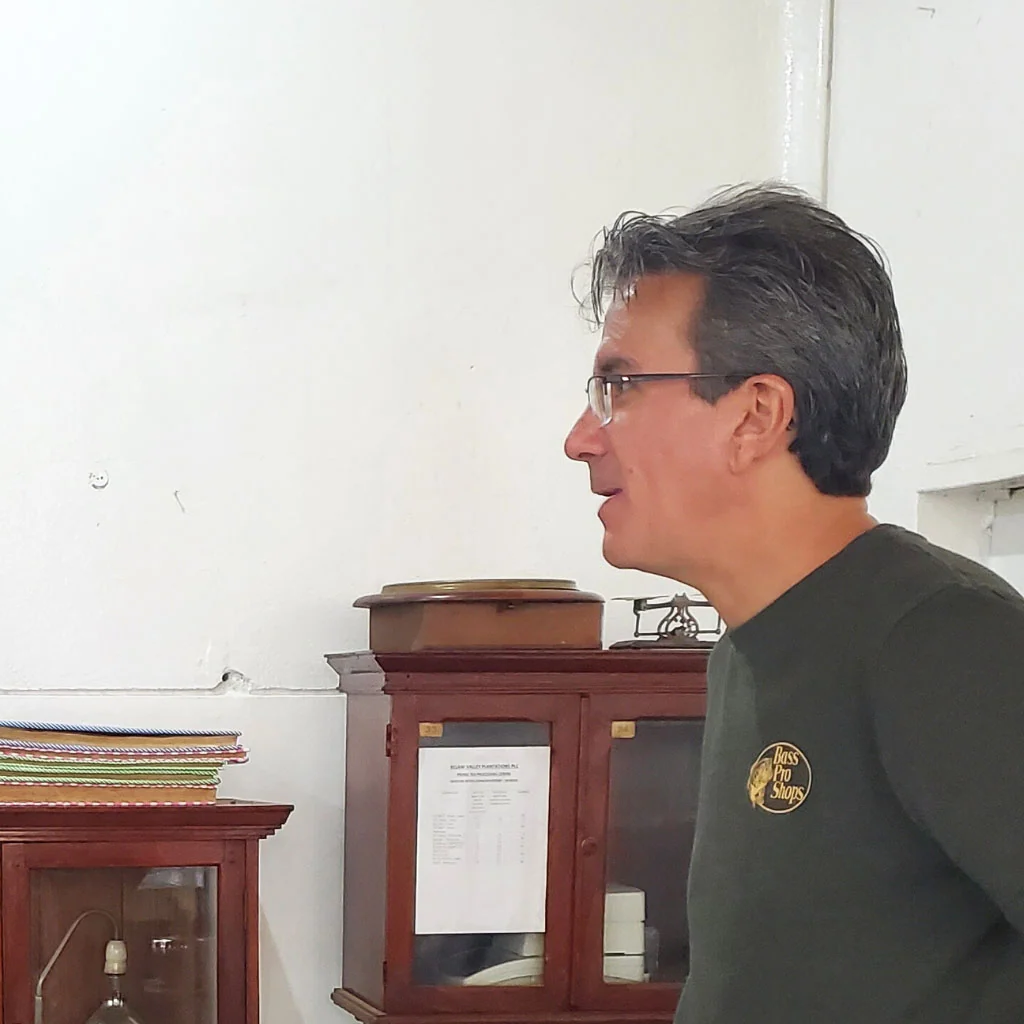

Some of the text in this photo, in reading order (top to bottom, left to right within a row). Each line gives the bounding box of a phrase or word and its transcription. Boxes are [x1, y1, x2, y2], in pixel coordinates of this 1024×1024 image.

[773, 745, 799, 766] Bass
[772, 764, 792, 783] Pro
[770, 781, 805, 805] Shops
